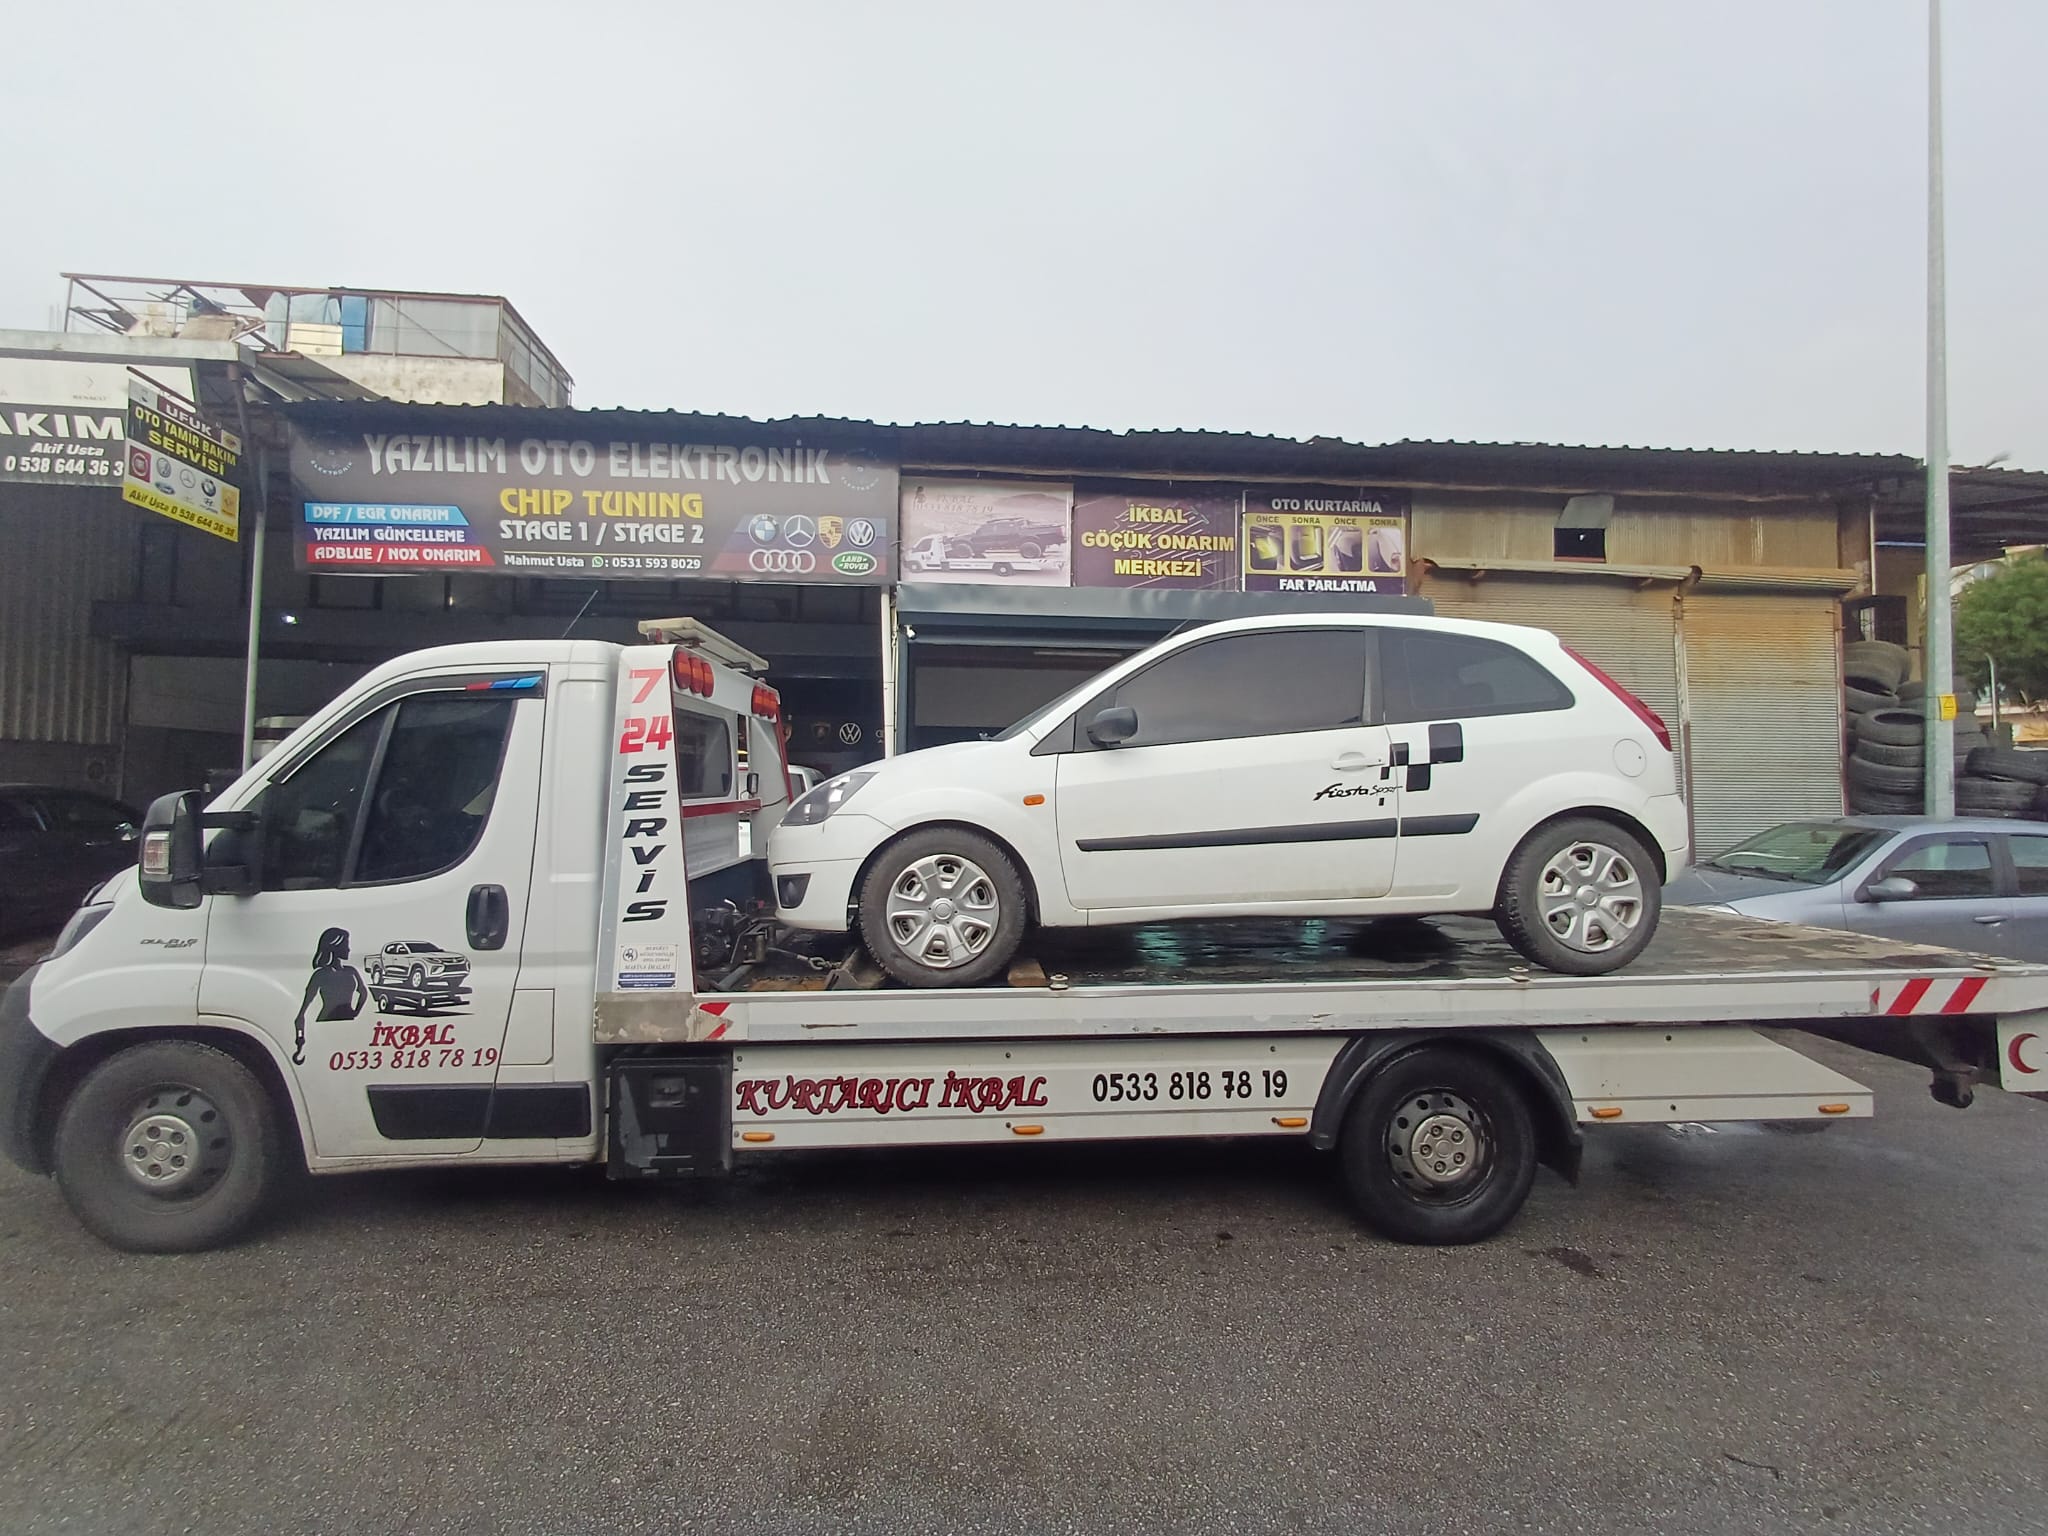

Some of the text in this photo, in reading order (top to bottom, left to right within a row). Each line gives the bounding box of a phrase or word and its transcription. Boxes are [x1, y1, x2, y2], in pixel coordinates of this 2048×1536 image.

[166, 404, 211, 436] UFUK
[135, 406, 160, 428] OTO
[202, 439, 236, 467] BAKIM
[30, 442, 104, 456] Akif Usta
[148, 429, 225, 476] SERVİSİ
[363, 434, 506, 475] YAZILIM
[520, 439, 596, 477] OTO
[609, 439, 831, 485] ELEKTRONİK
[5, 455, 16, 471] 0
[20, 457, 50, 473] 538
[54, 458, 85, 474] 644
[89, 460, 110, 476] 36
[129, 490, 149, 505] Akif
[149, 496, 169, 511] Usta
[500, 488, 704, 519] CHIP TUNING
[1271, 498, 1382, 513] OTO KURTARMA
[313, 506, 341, 519] DPF
[357, 507, 385, 520] EGR
[391, 508, 449, 521] ONARIM
[1128, 503, 1188, 524] İKBAL
[1292, 516, 1321, 525] SONRA
[314, 526, 465, 543] YAZILIM GÜNCELLEME
[500, 520, 572, 542] STAGE
[579, 522, 588, 540] 1
[614, 522, 685, 544] STAGE
[692, 524, 704, 544] 2
[1081, 530, 1234, 552] GÖÇÜK ONARIM
[315, 546, 372, 561] ADBLUE
[388, 547, 419, 561] NOX
[423, 548, 481, 562] ONARIM
[504, 554, 584, 568] Mahmut Usta
[612, 557, 642, 569] 0531
[645, 558, 668, 569] 593
[671, 558, 701, 570] 8029
[842, 555, 863, 563] LAND
[843, 562, 869, 570] ROVER
[1113, 558, 1202, 577] MERKEZİ
[1279, 578, 1377, 592] FAR PARLATMA
[629, 668, 666, 703] 7
[619, 715, 672, 754] 24
[369, 1021, 456, 1050] İKBAL
[329, 1048, 498, 1071] 0533 818 78 19
[735, 1070, 1048, 1115] KURTARICI İKBAL
[1092, 1069, 1288, 1102] 0533 818 78 19
